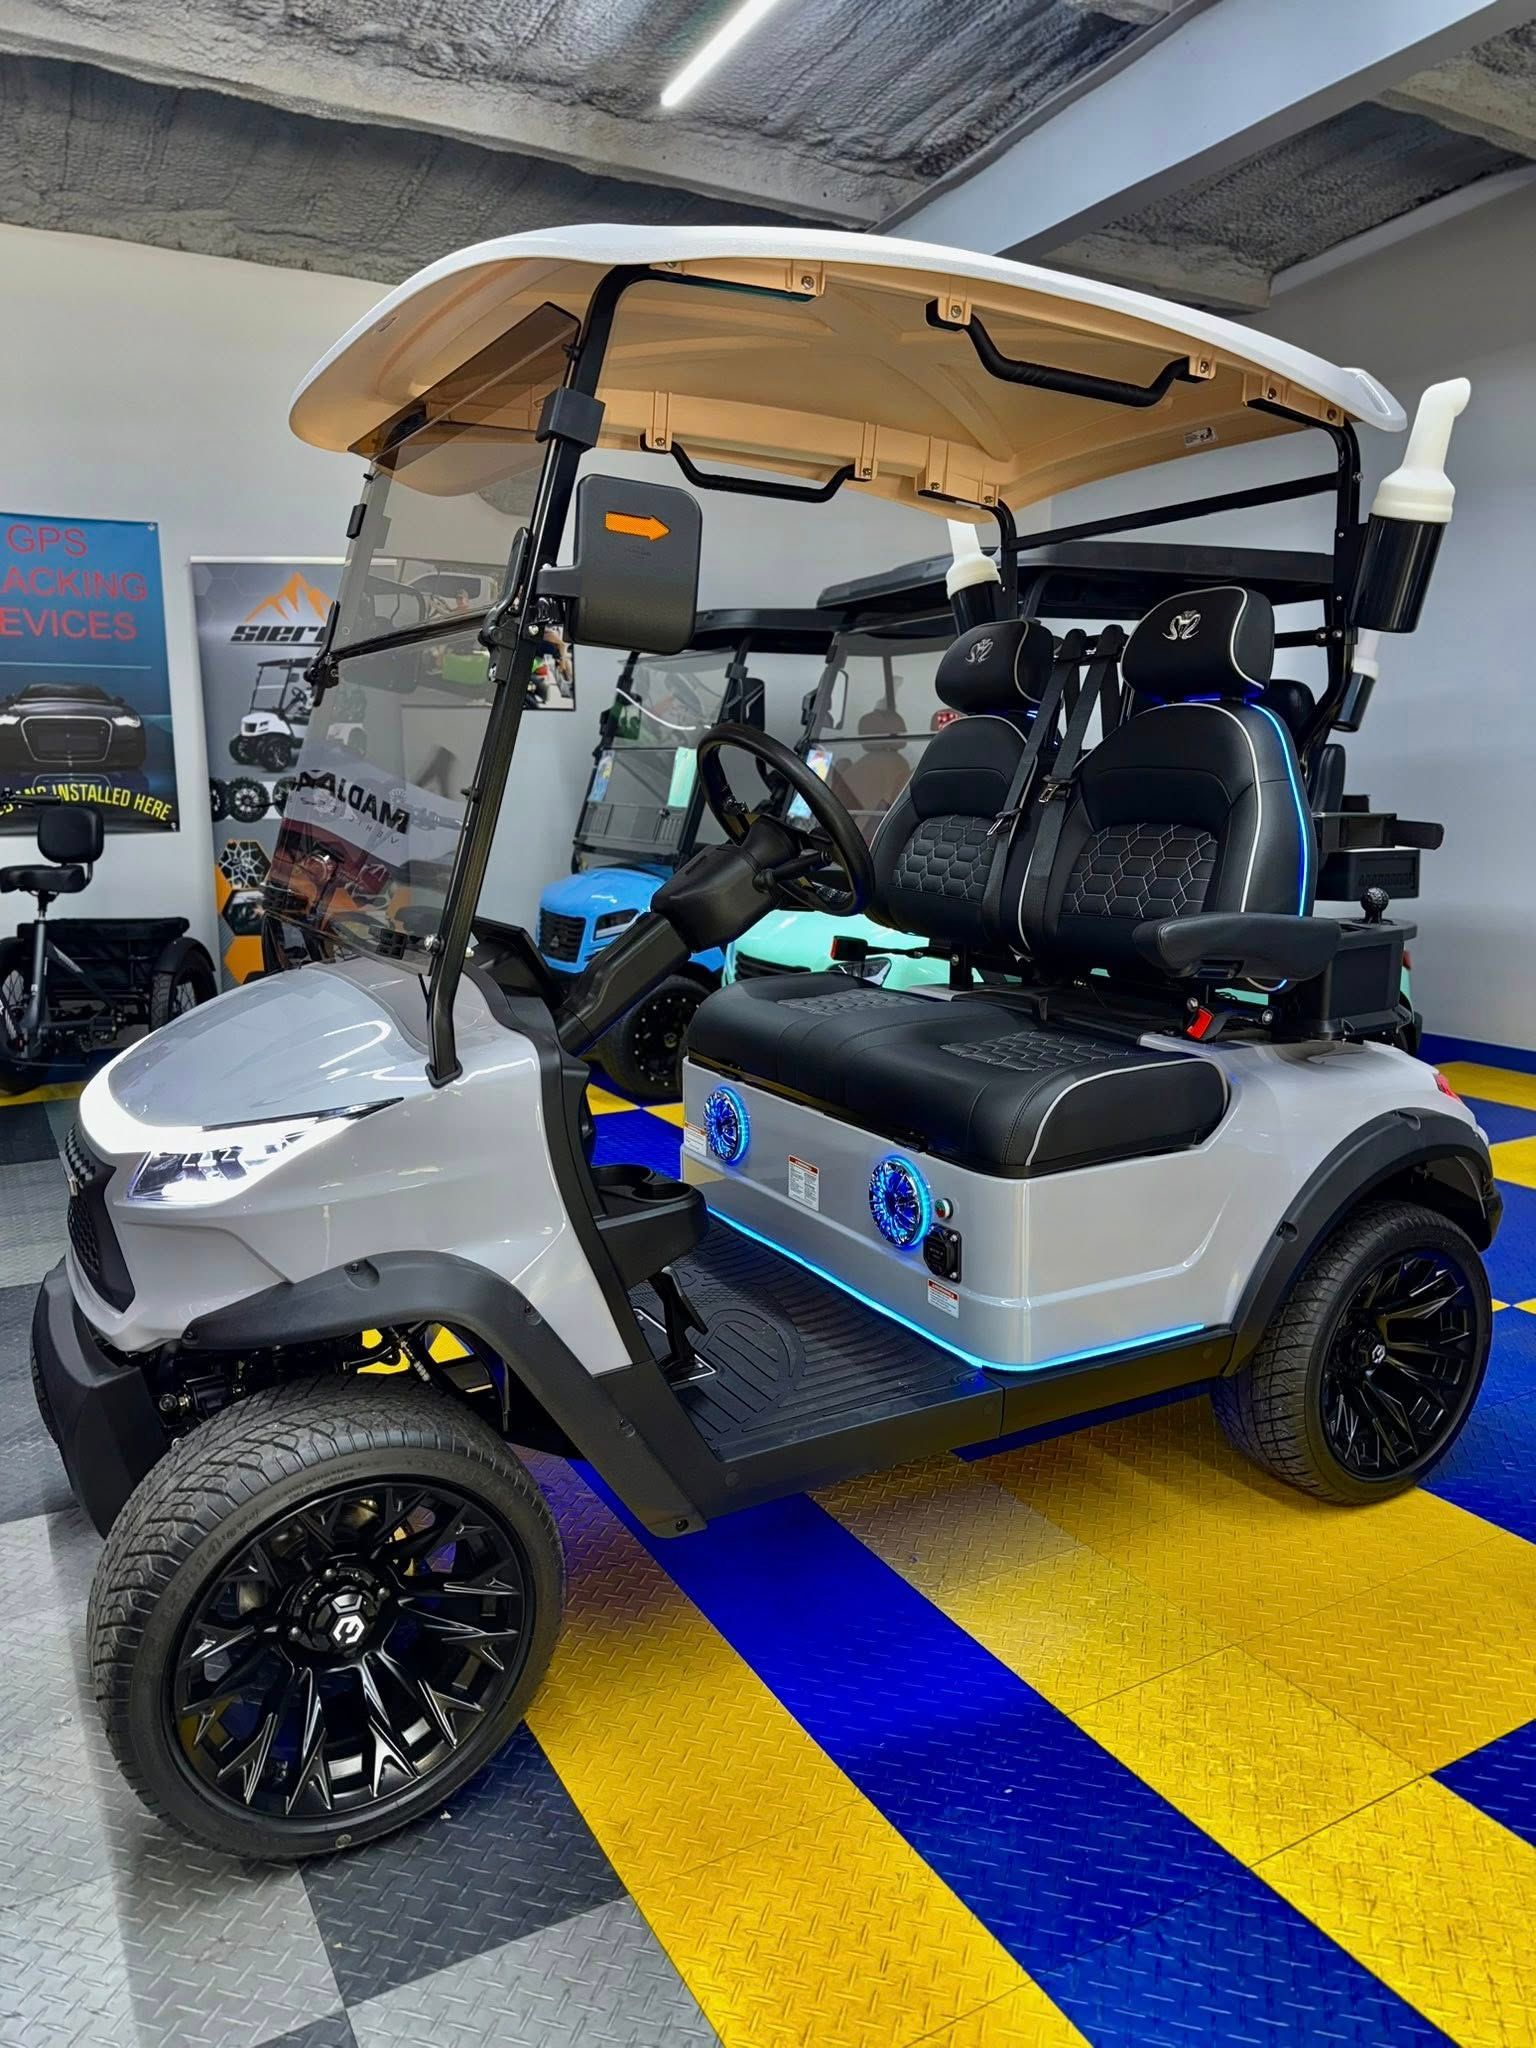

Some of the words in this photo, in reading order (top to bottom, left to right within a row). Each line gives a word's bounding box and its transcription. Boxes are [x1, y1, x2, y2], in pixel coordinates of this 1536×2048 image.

[6, 524, 88, 557] GPS
[0, 566, 148, 601] ACKING
[0, 606, 137, 640] EVICES
[52, 783, 131, 807] INSTALLED
[133, 793, 172, 821] HERE
